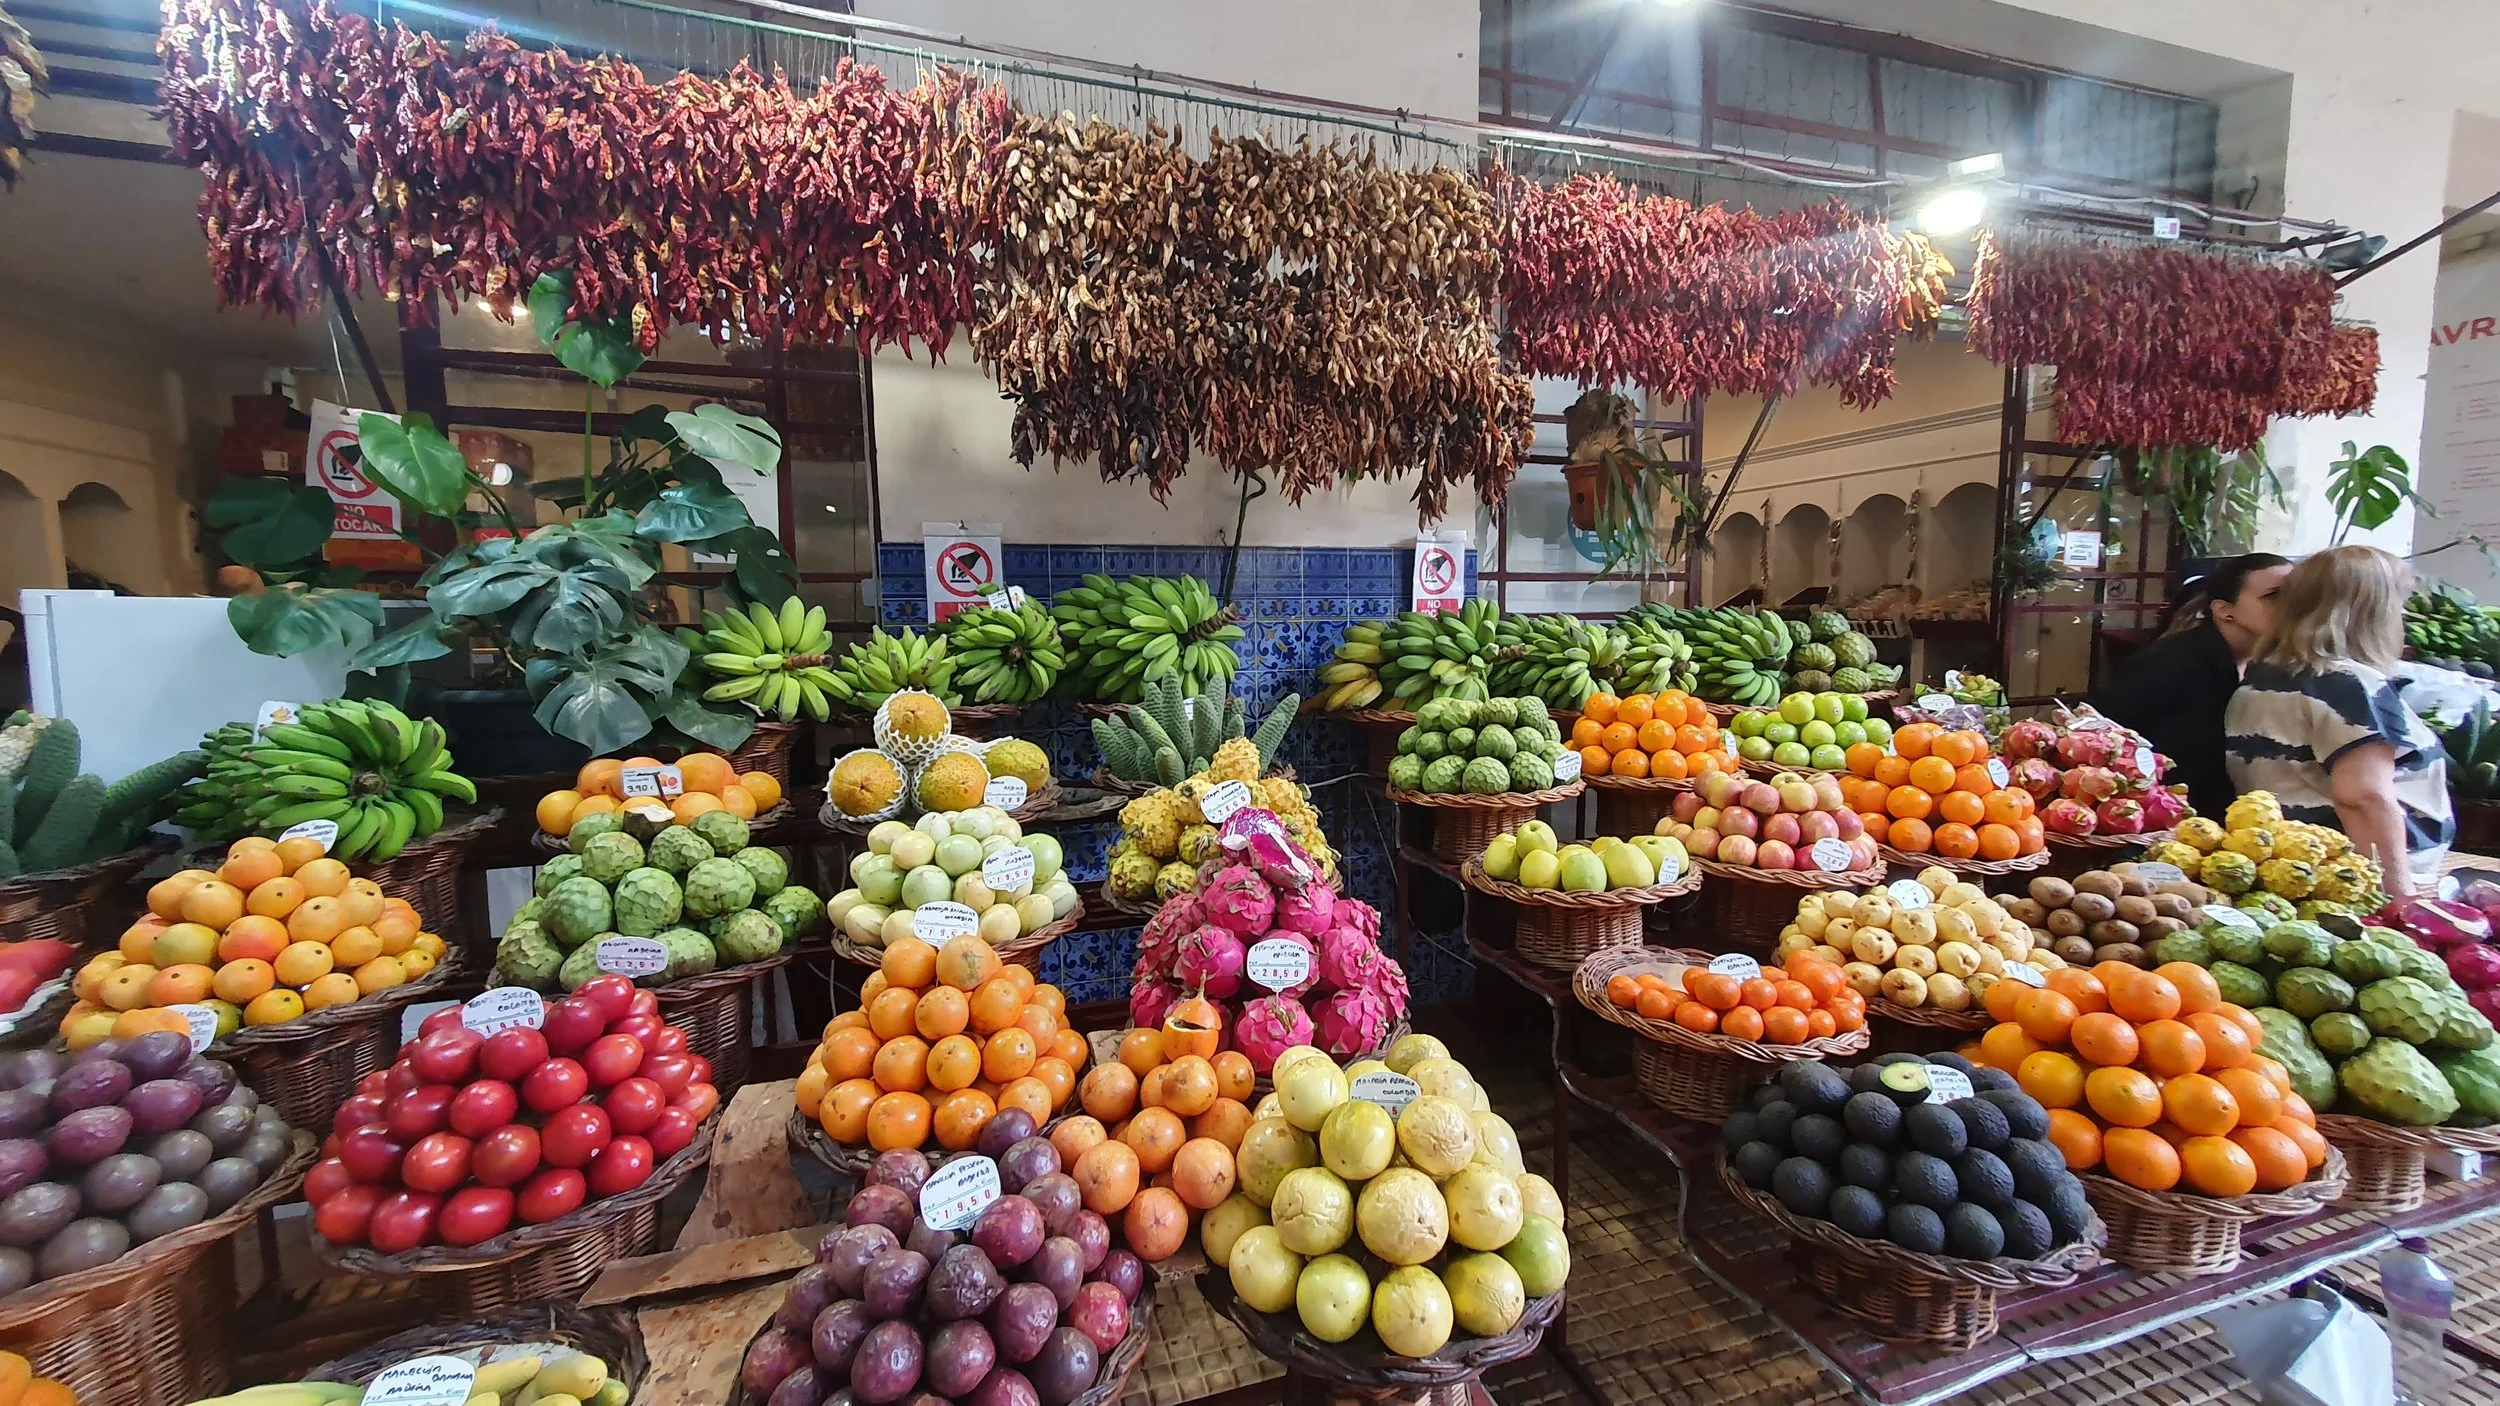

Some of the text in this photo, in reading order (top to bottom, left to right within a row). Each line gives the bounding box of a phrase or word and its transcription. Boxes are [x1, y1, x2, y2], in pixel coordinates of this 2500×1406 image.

[343, 505, 366, 517] NO
[1427, 600, 1441, 609] NO
[1262, 968, 1299, 979] 28,50
[944, 1189, 991, 1219] 19,50
